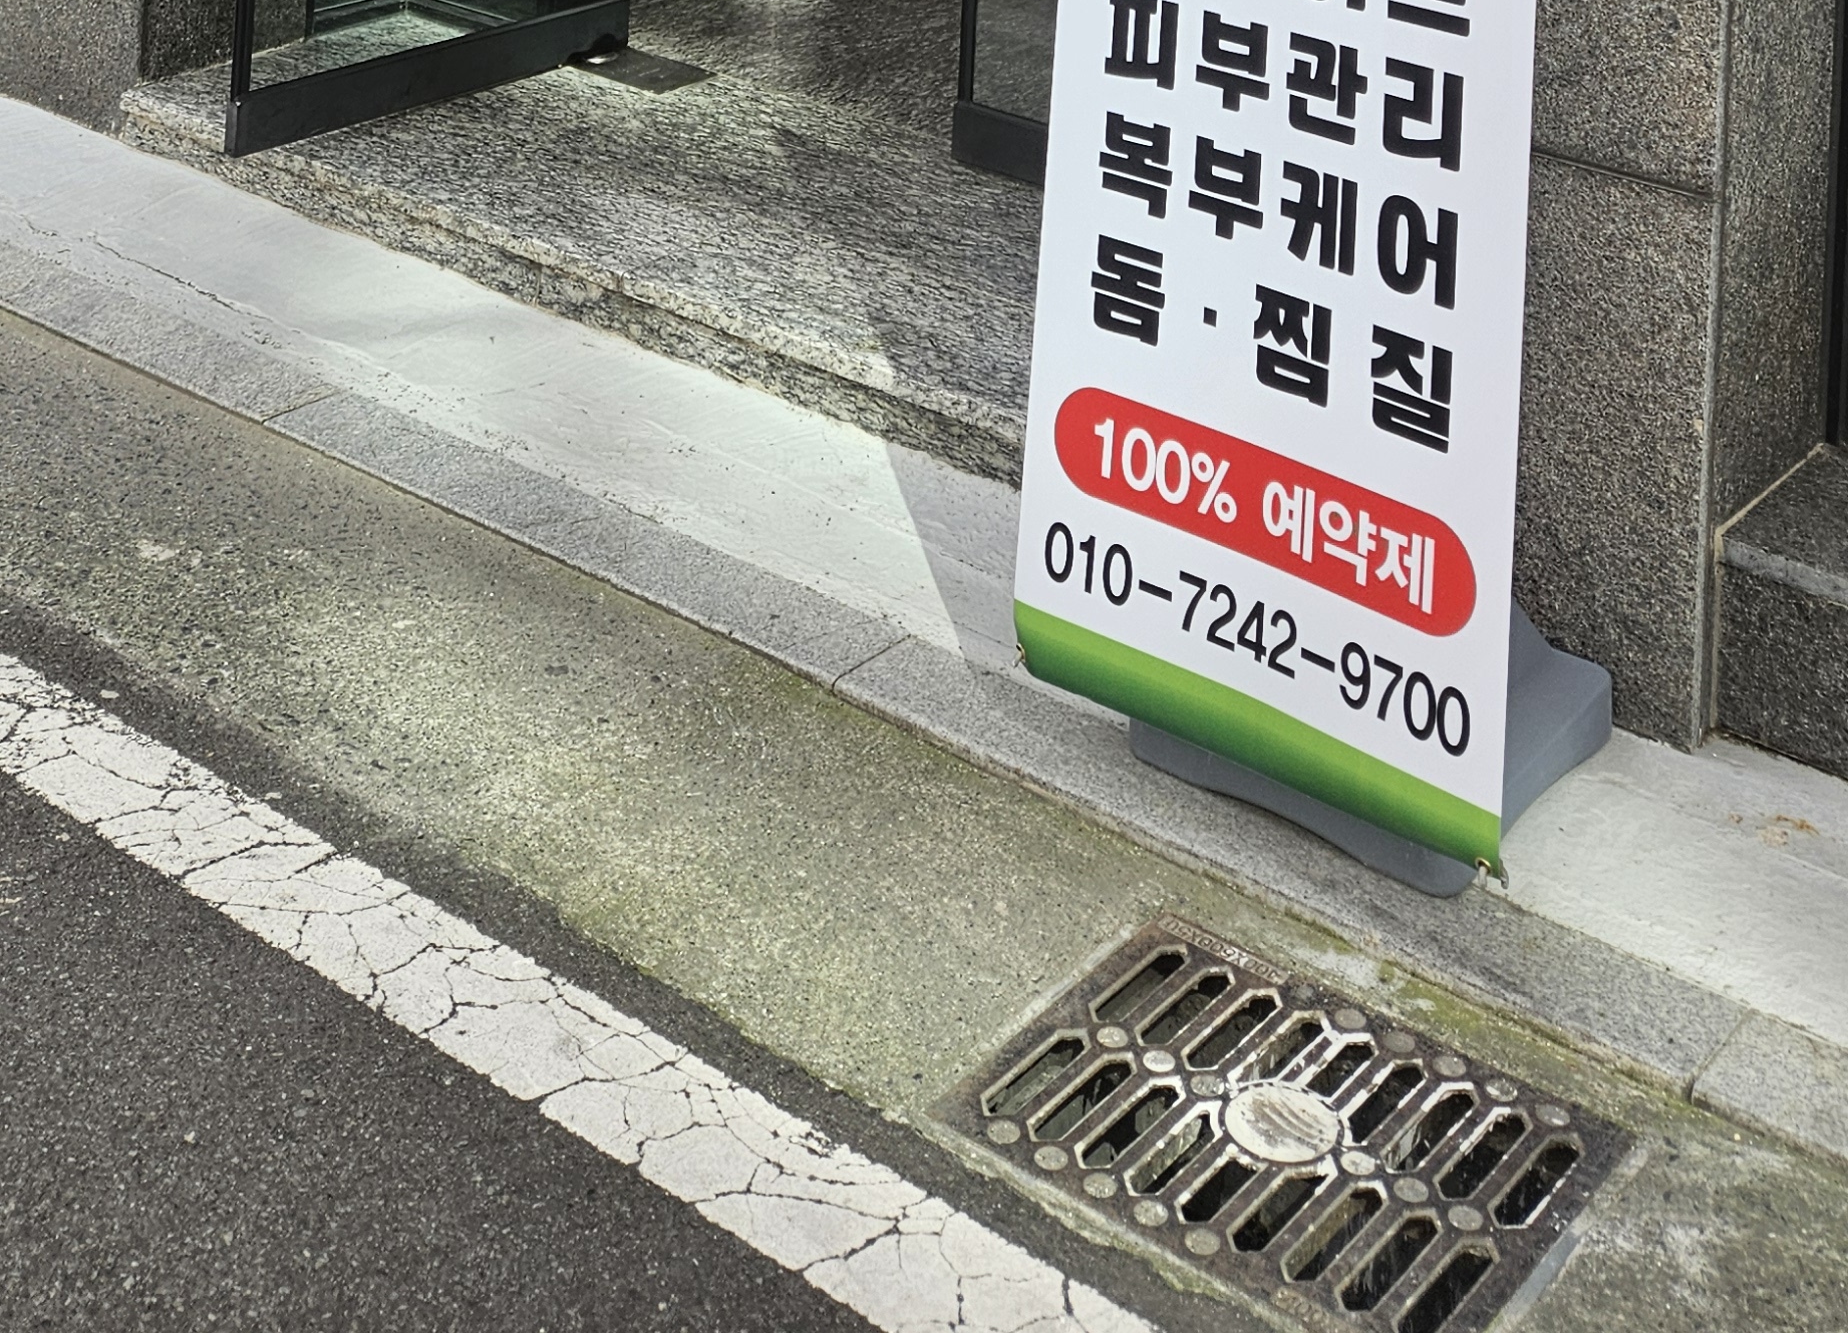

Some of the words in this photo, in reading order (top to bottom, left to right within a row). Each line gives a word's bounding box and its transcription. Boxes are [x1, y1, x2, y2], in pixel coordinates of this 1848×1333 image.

[1098, 111, 1459, 310] 복부케어
[1093, 417, 1238, 524] 100%
[1261, 479, 1436, 616] 예약제
[1044, 521, 1472, 758] 010-7242-9700
